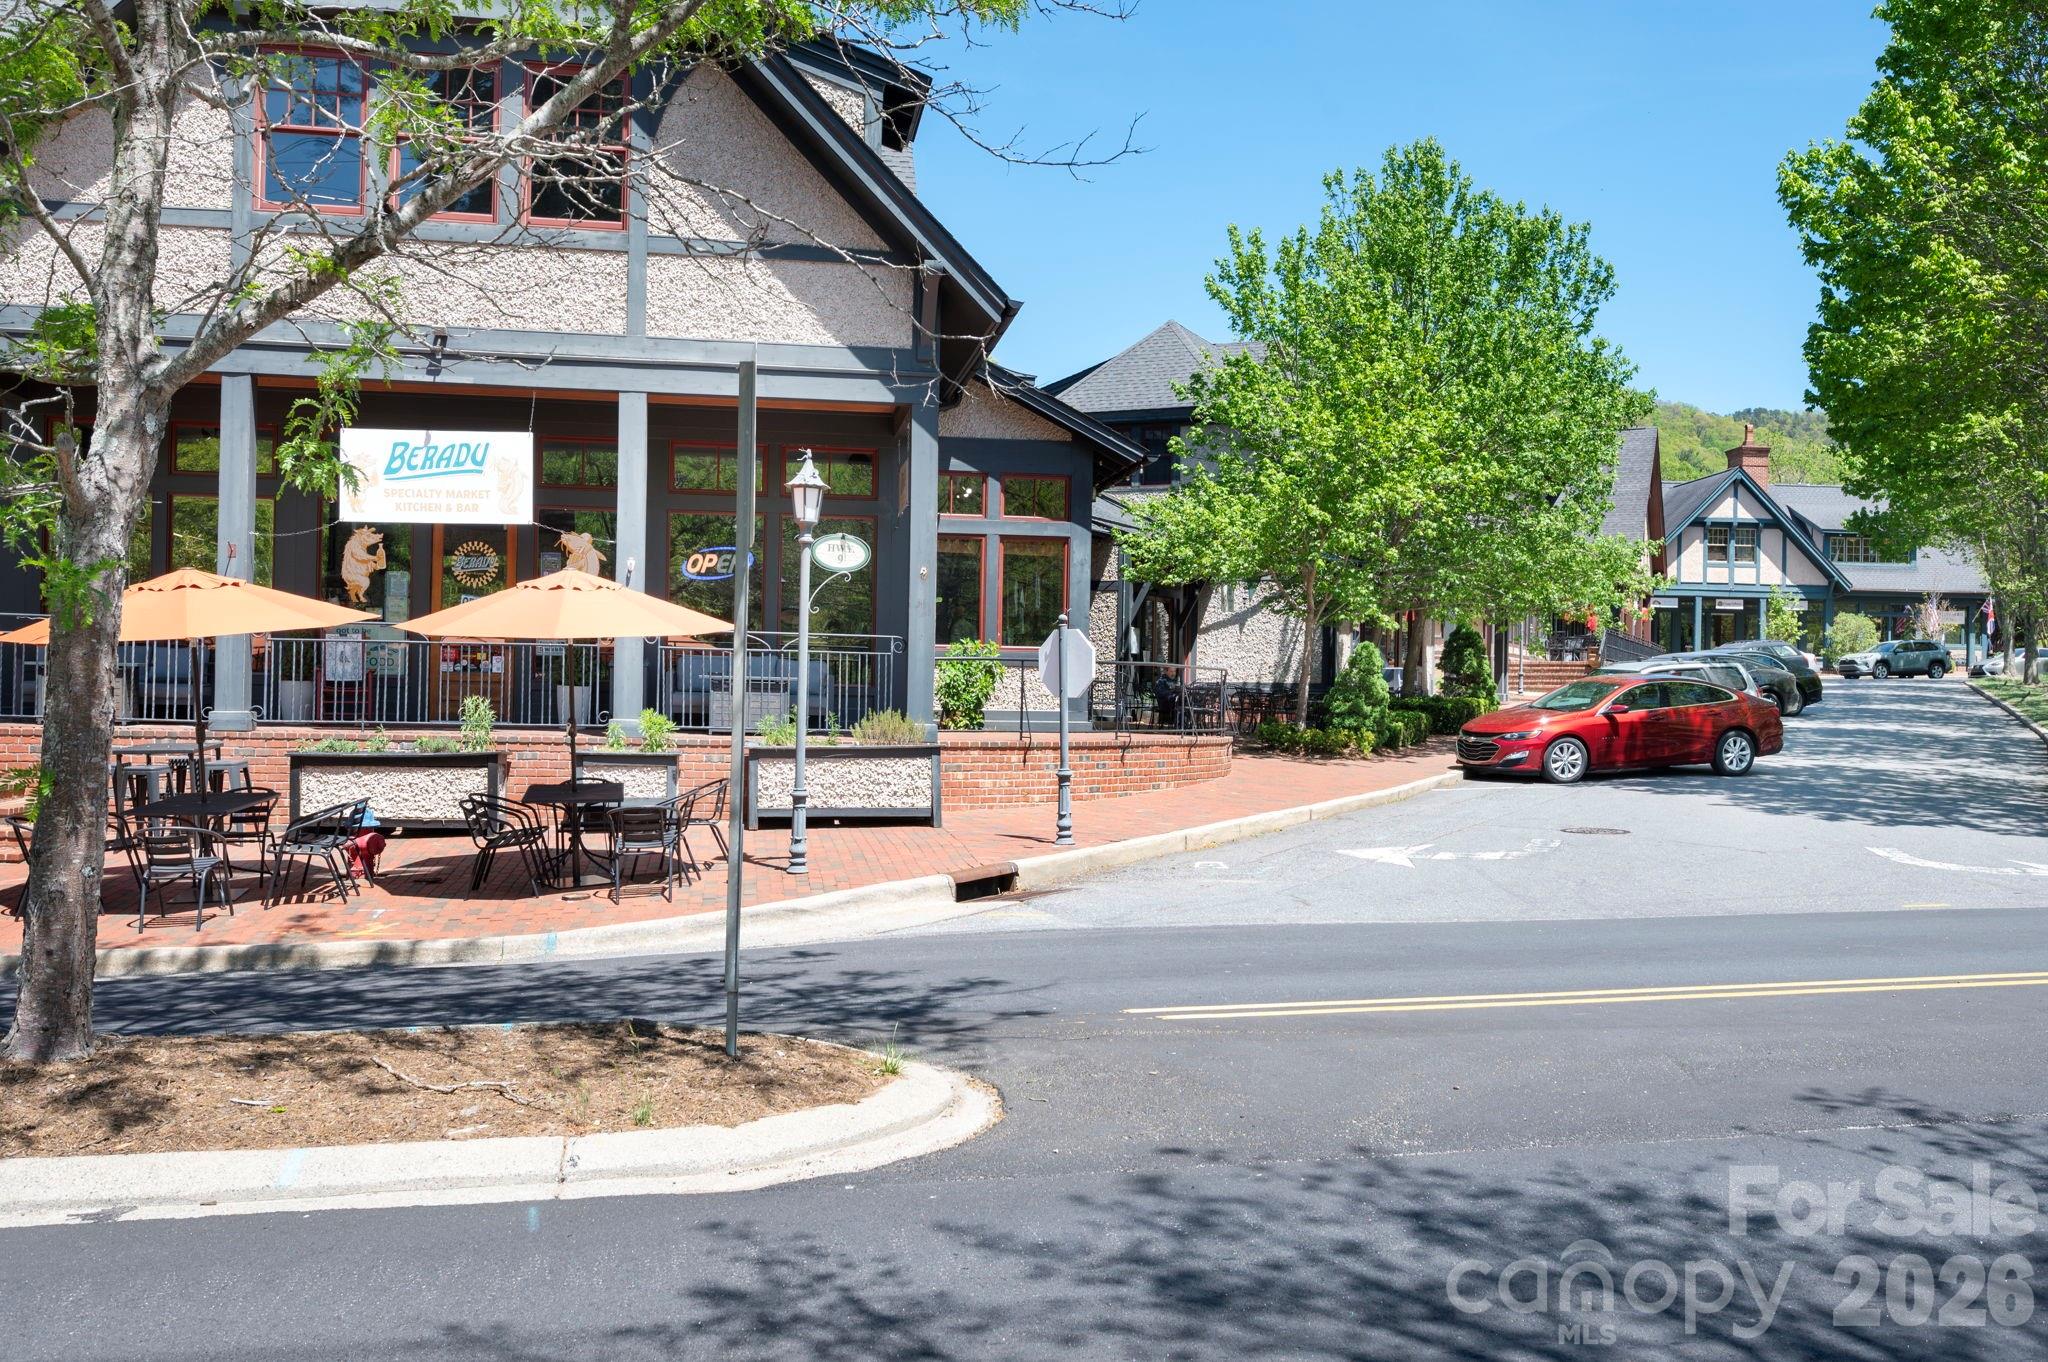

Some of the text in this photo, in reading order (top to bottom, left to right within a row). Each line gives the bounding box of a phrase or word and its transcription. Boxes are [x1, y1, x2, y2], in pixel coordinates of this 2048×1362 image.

[383, 441, 490, 476] BERADU
[383, 487, 491, 500] SPECIALTY MARKET
[395, 502, 480, 513] KITCHEN & BAR
